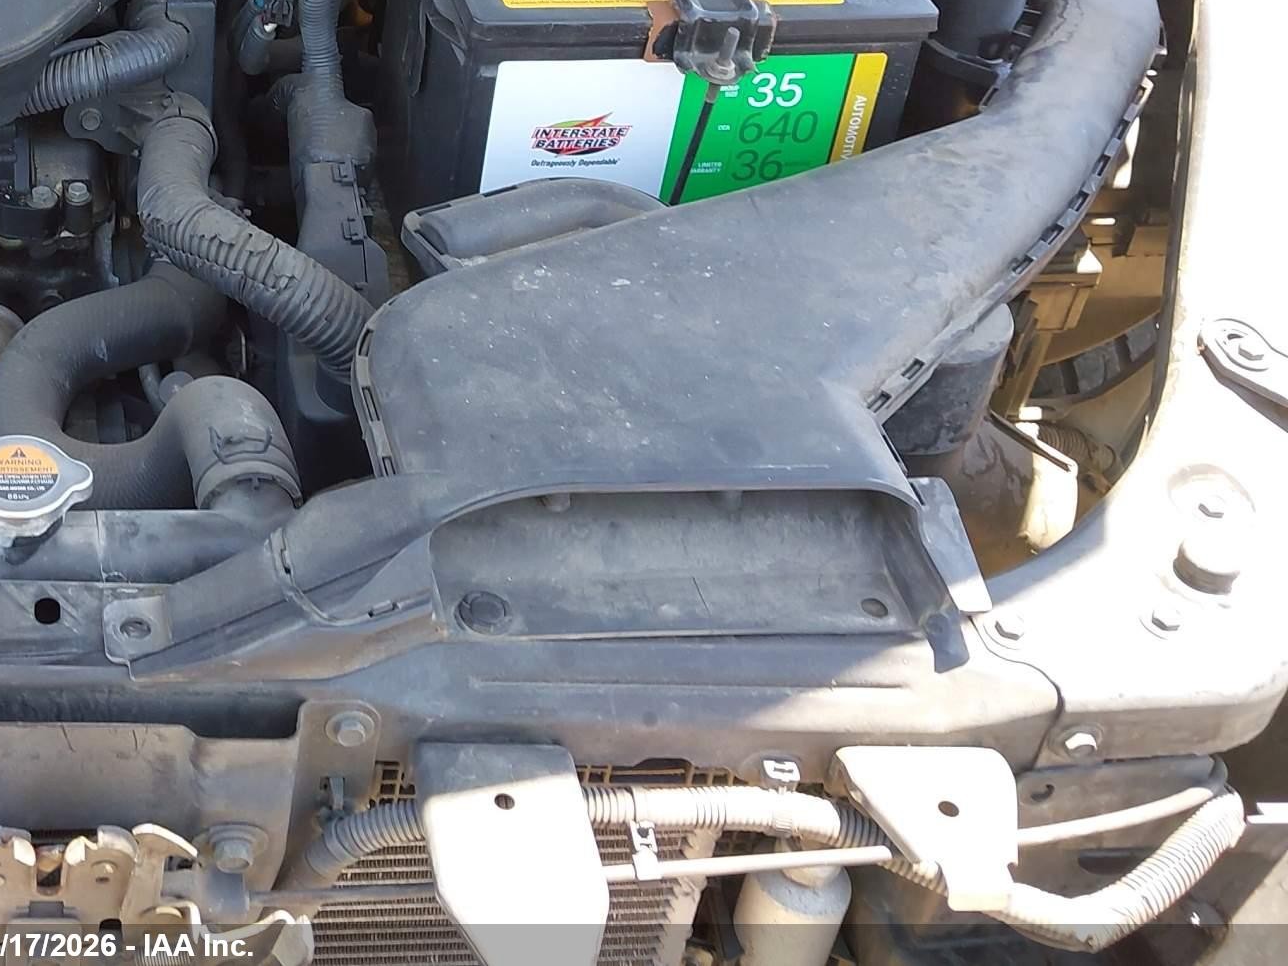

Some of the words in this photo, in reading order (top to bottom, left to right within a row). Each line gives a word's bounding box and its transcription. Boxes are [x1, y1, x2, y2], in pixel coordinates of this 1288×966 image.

[747, 72, 806, 107] 35
[535, 127, 629, 138] INTERSTATE
[535, 138, 619, 149] BATTERIES
[739, 111, 819, 144] 640
[731, 149, 782, 182] 36
